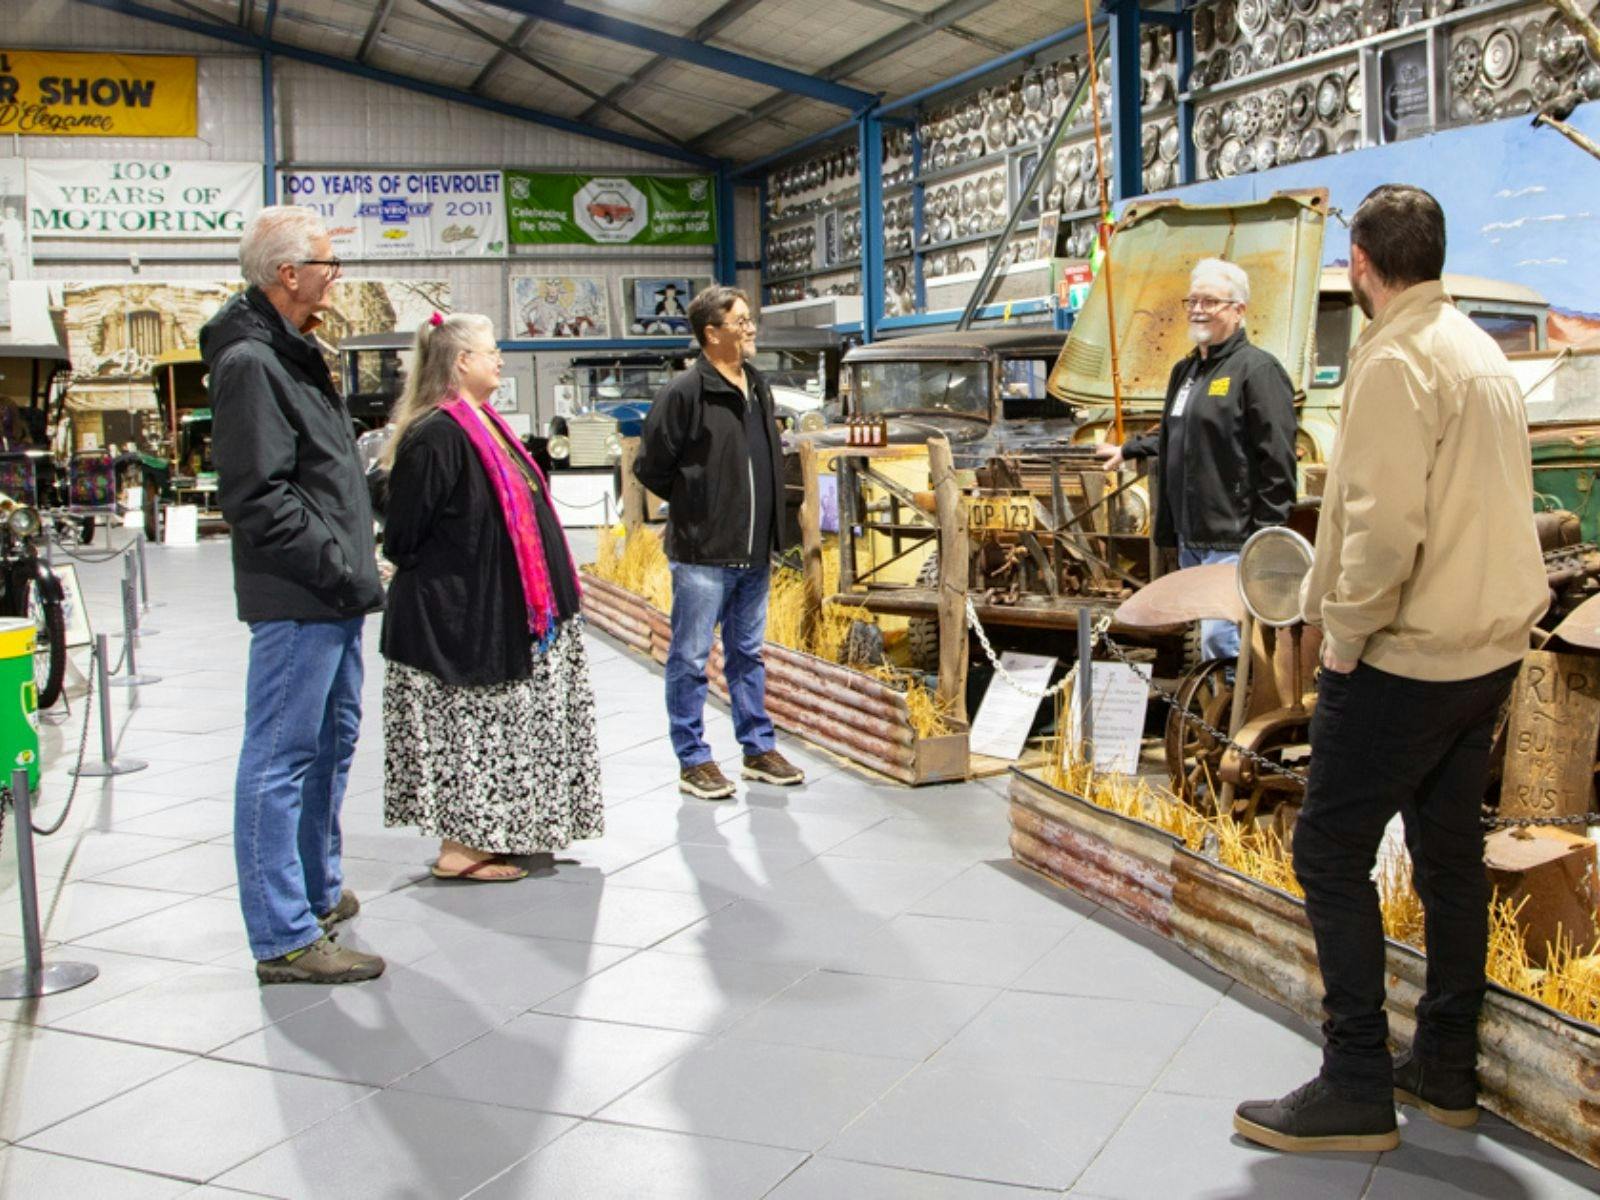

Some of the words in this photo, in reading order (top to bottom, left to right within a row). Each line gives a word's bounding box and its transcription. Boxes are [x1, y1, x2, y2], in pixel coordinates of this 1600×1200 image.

[39, 77, 155, 108] SHOW
[109, 162, 171, 180] 100
[282, 175, 315, 194] 100
[322, 175, 372, 194] YEARS
[379, 175, 400, 193] OF
[407, 174, 500, 194] CHEVROLET
[60, 186, 164, 204] YEARS
[183, 187, 221, 204] OF
[445, 201, 493, 216] 2011
[32, 208, 246, 231] MOTORING
[1003, 504, 1031, 529] 123
[1517, 784, 1575, 809] RUST
